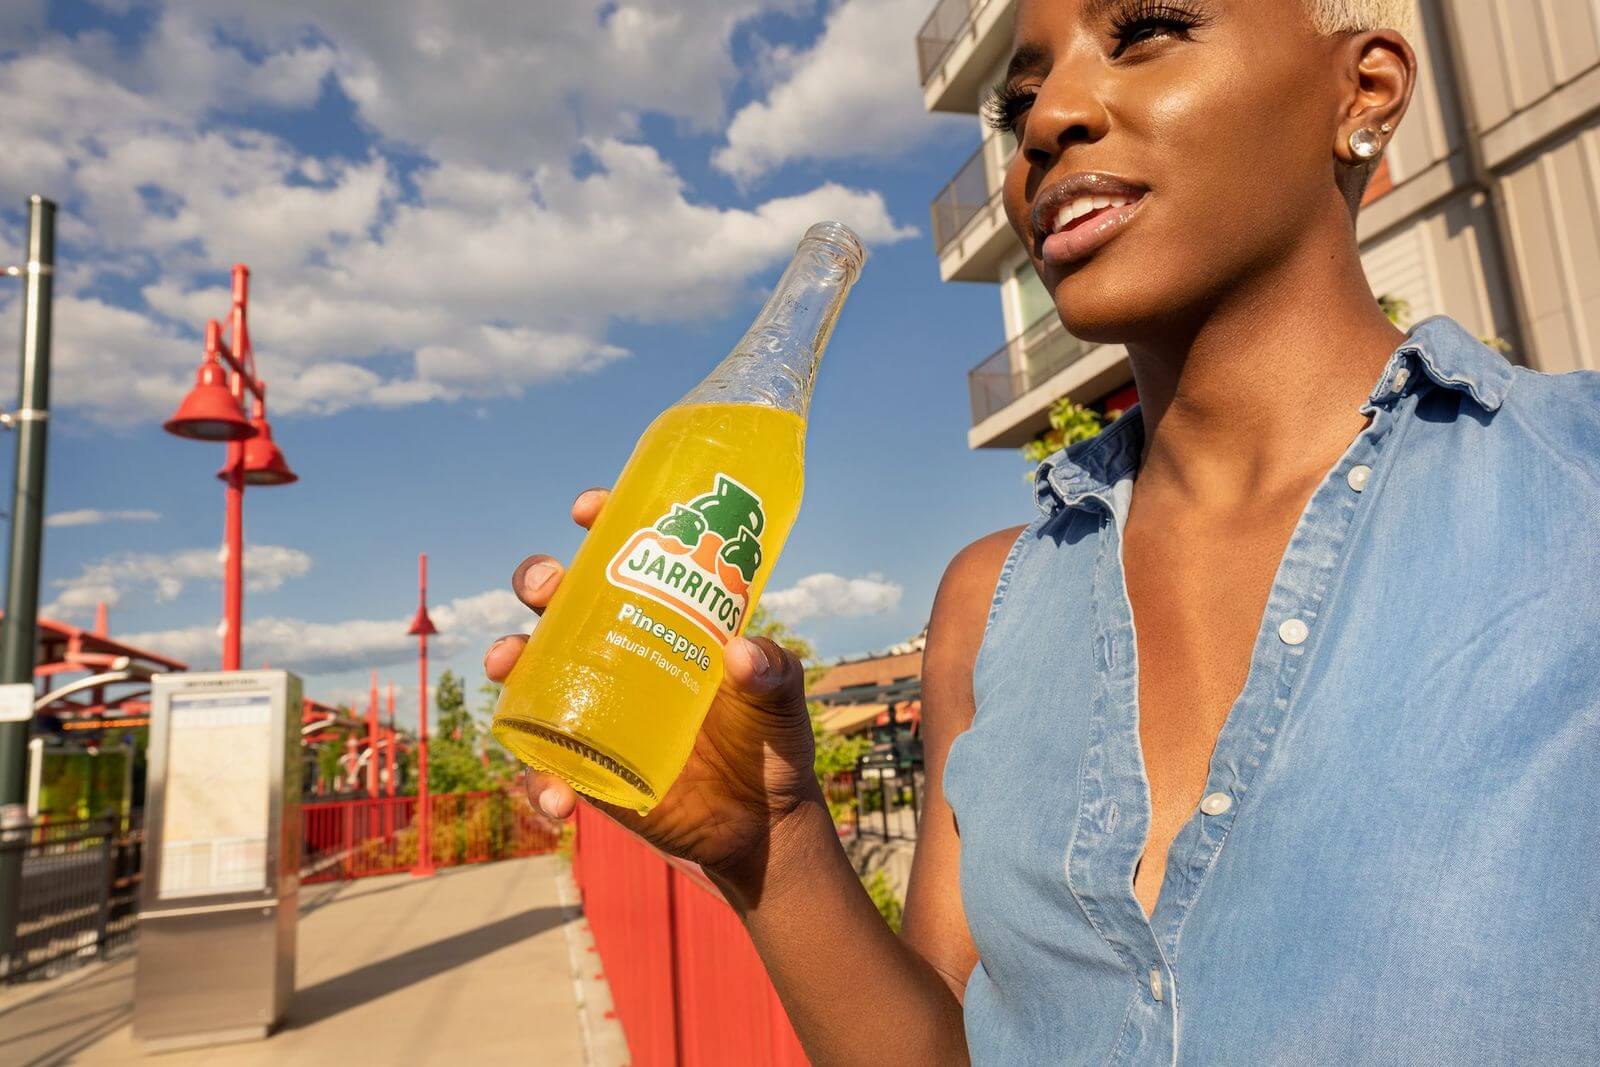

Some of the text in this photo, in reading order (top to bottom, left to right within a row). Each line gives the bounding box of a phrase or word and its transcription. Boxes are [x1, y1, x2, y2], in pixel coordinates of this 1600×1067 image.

[628, 549, 741, 632] JARRITOS
[605, 631, 650, 658] Natural
[649, 650, 682, 678] Flavor
[616, 603, 711, 671] Pineapple
